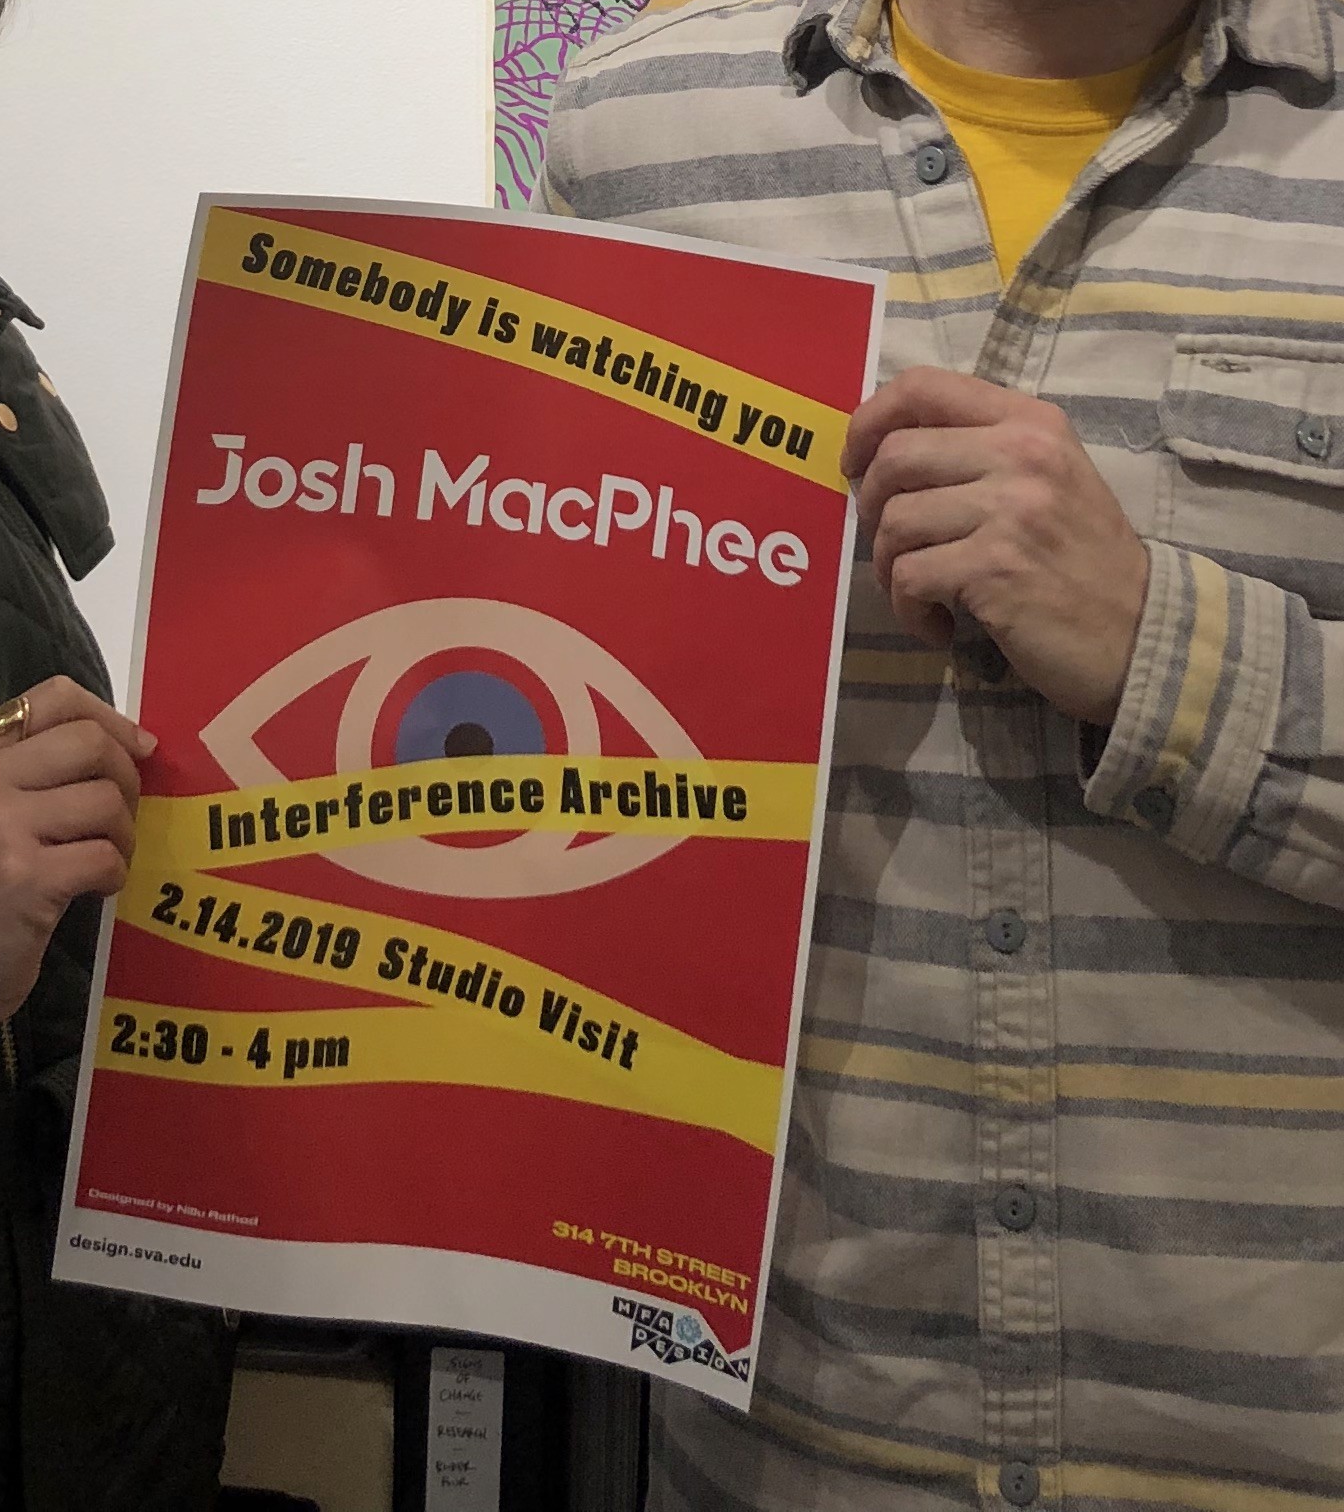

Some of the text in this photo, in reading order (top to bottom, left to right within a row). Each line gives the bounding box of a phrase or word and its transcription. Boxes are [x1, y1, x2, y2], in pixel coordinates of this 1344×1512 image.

[241, 232, 815, 462] Somebody is watching you
[195, 432, 810, 587] Josh MacPhee
[208, 766, 748, 852] Interference Archive
[151, 882, 639, 1071] 2.14.2019 Studio Visit
[111, 1013, 209, 1065] 2:30
[247, 1028, 271, 1071] 4
[284, 1034, 350, 1080] pm
[88, 1188, 155, 1208] Designed
[157, 1199, 174, 1213] by
[69, 1234, 202, 1270] design.sva.edu
[552, 1220, 752, 1290] 314 7TH STREET
[613, 1258, 748, 1315] BROOKLYN
[617, 1301, 670, 1332] MFA
[634, 1328, 749, 1374] DESIGN
